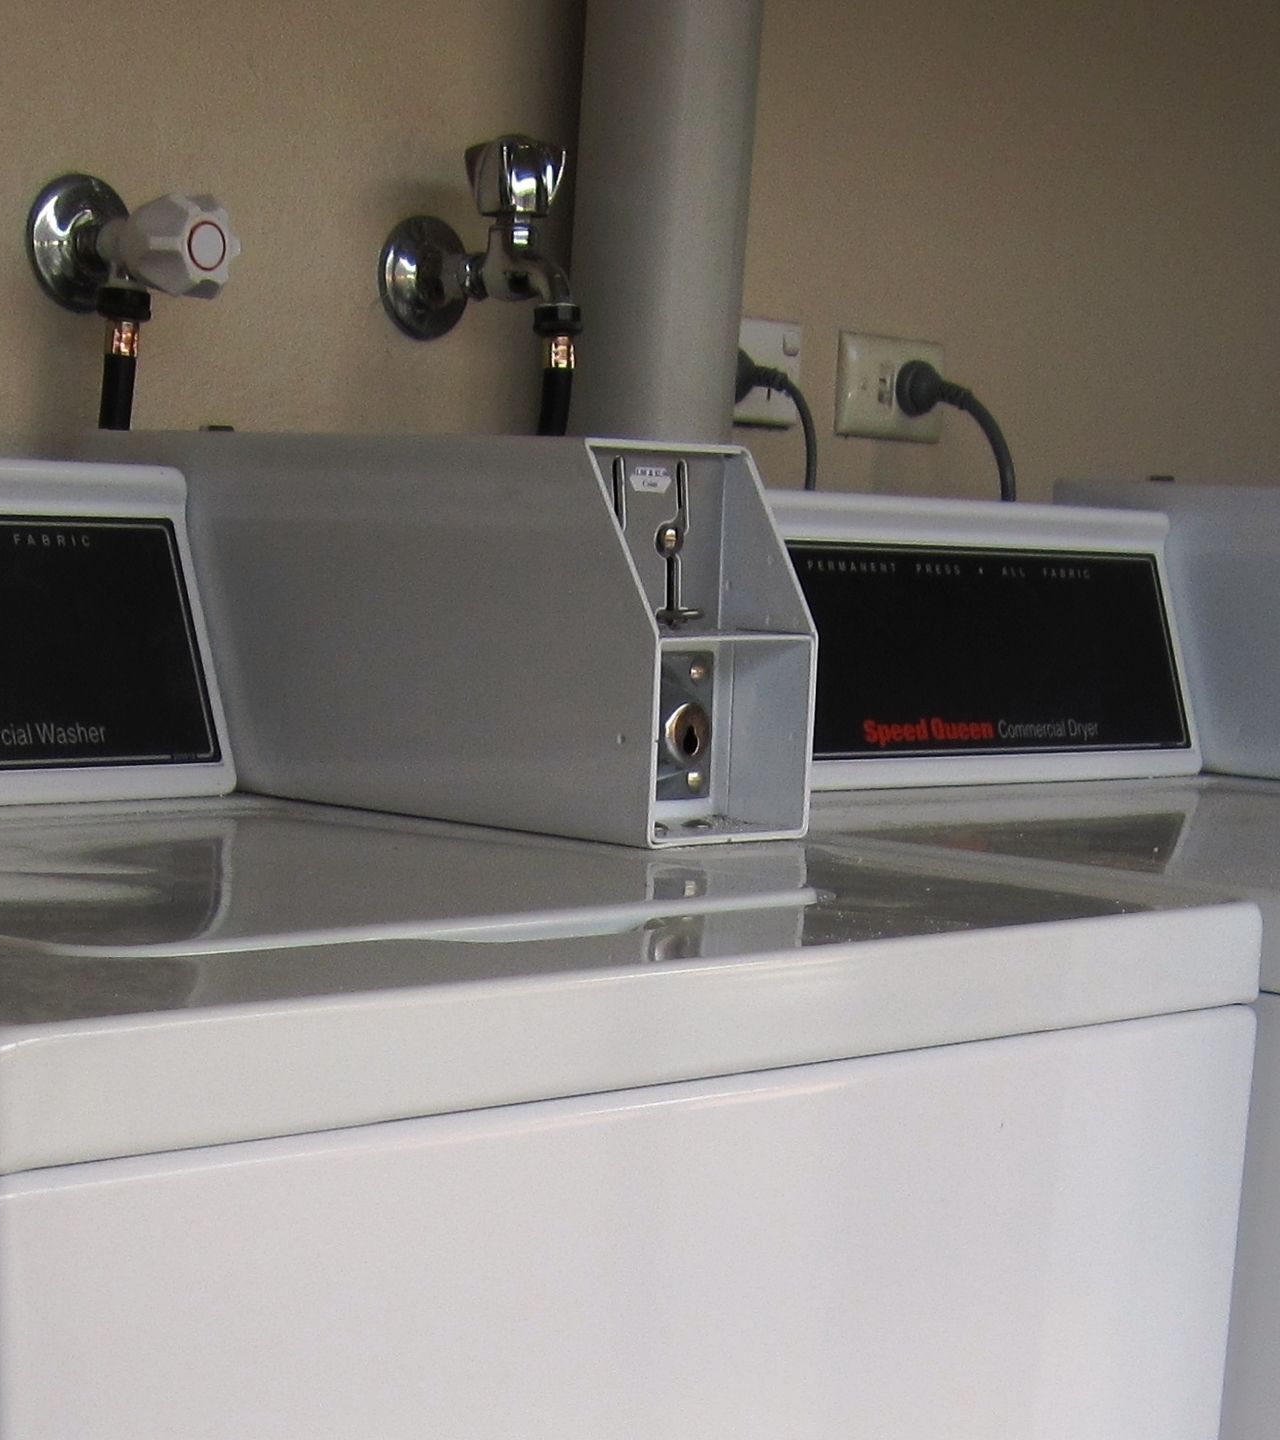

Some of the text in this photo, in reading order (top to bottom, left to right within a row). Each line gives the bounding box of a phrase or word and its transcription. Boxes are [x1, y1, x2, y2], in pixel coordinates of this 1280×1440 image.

[13, 533, 92, 548] FABRIC
[807, 559, 1090, 579] PERMANENT PRESS ALL FABRIC
[35, 722, 106, 745] Washer
[863, 717, 1099, 748] Speed Queen Commercial Dryer
